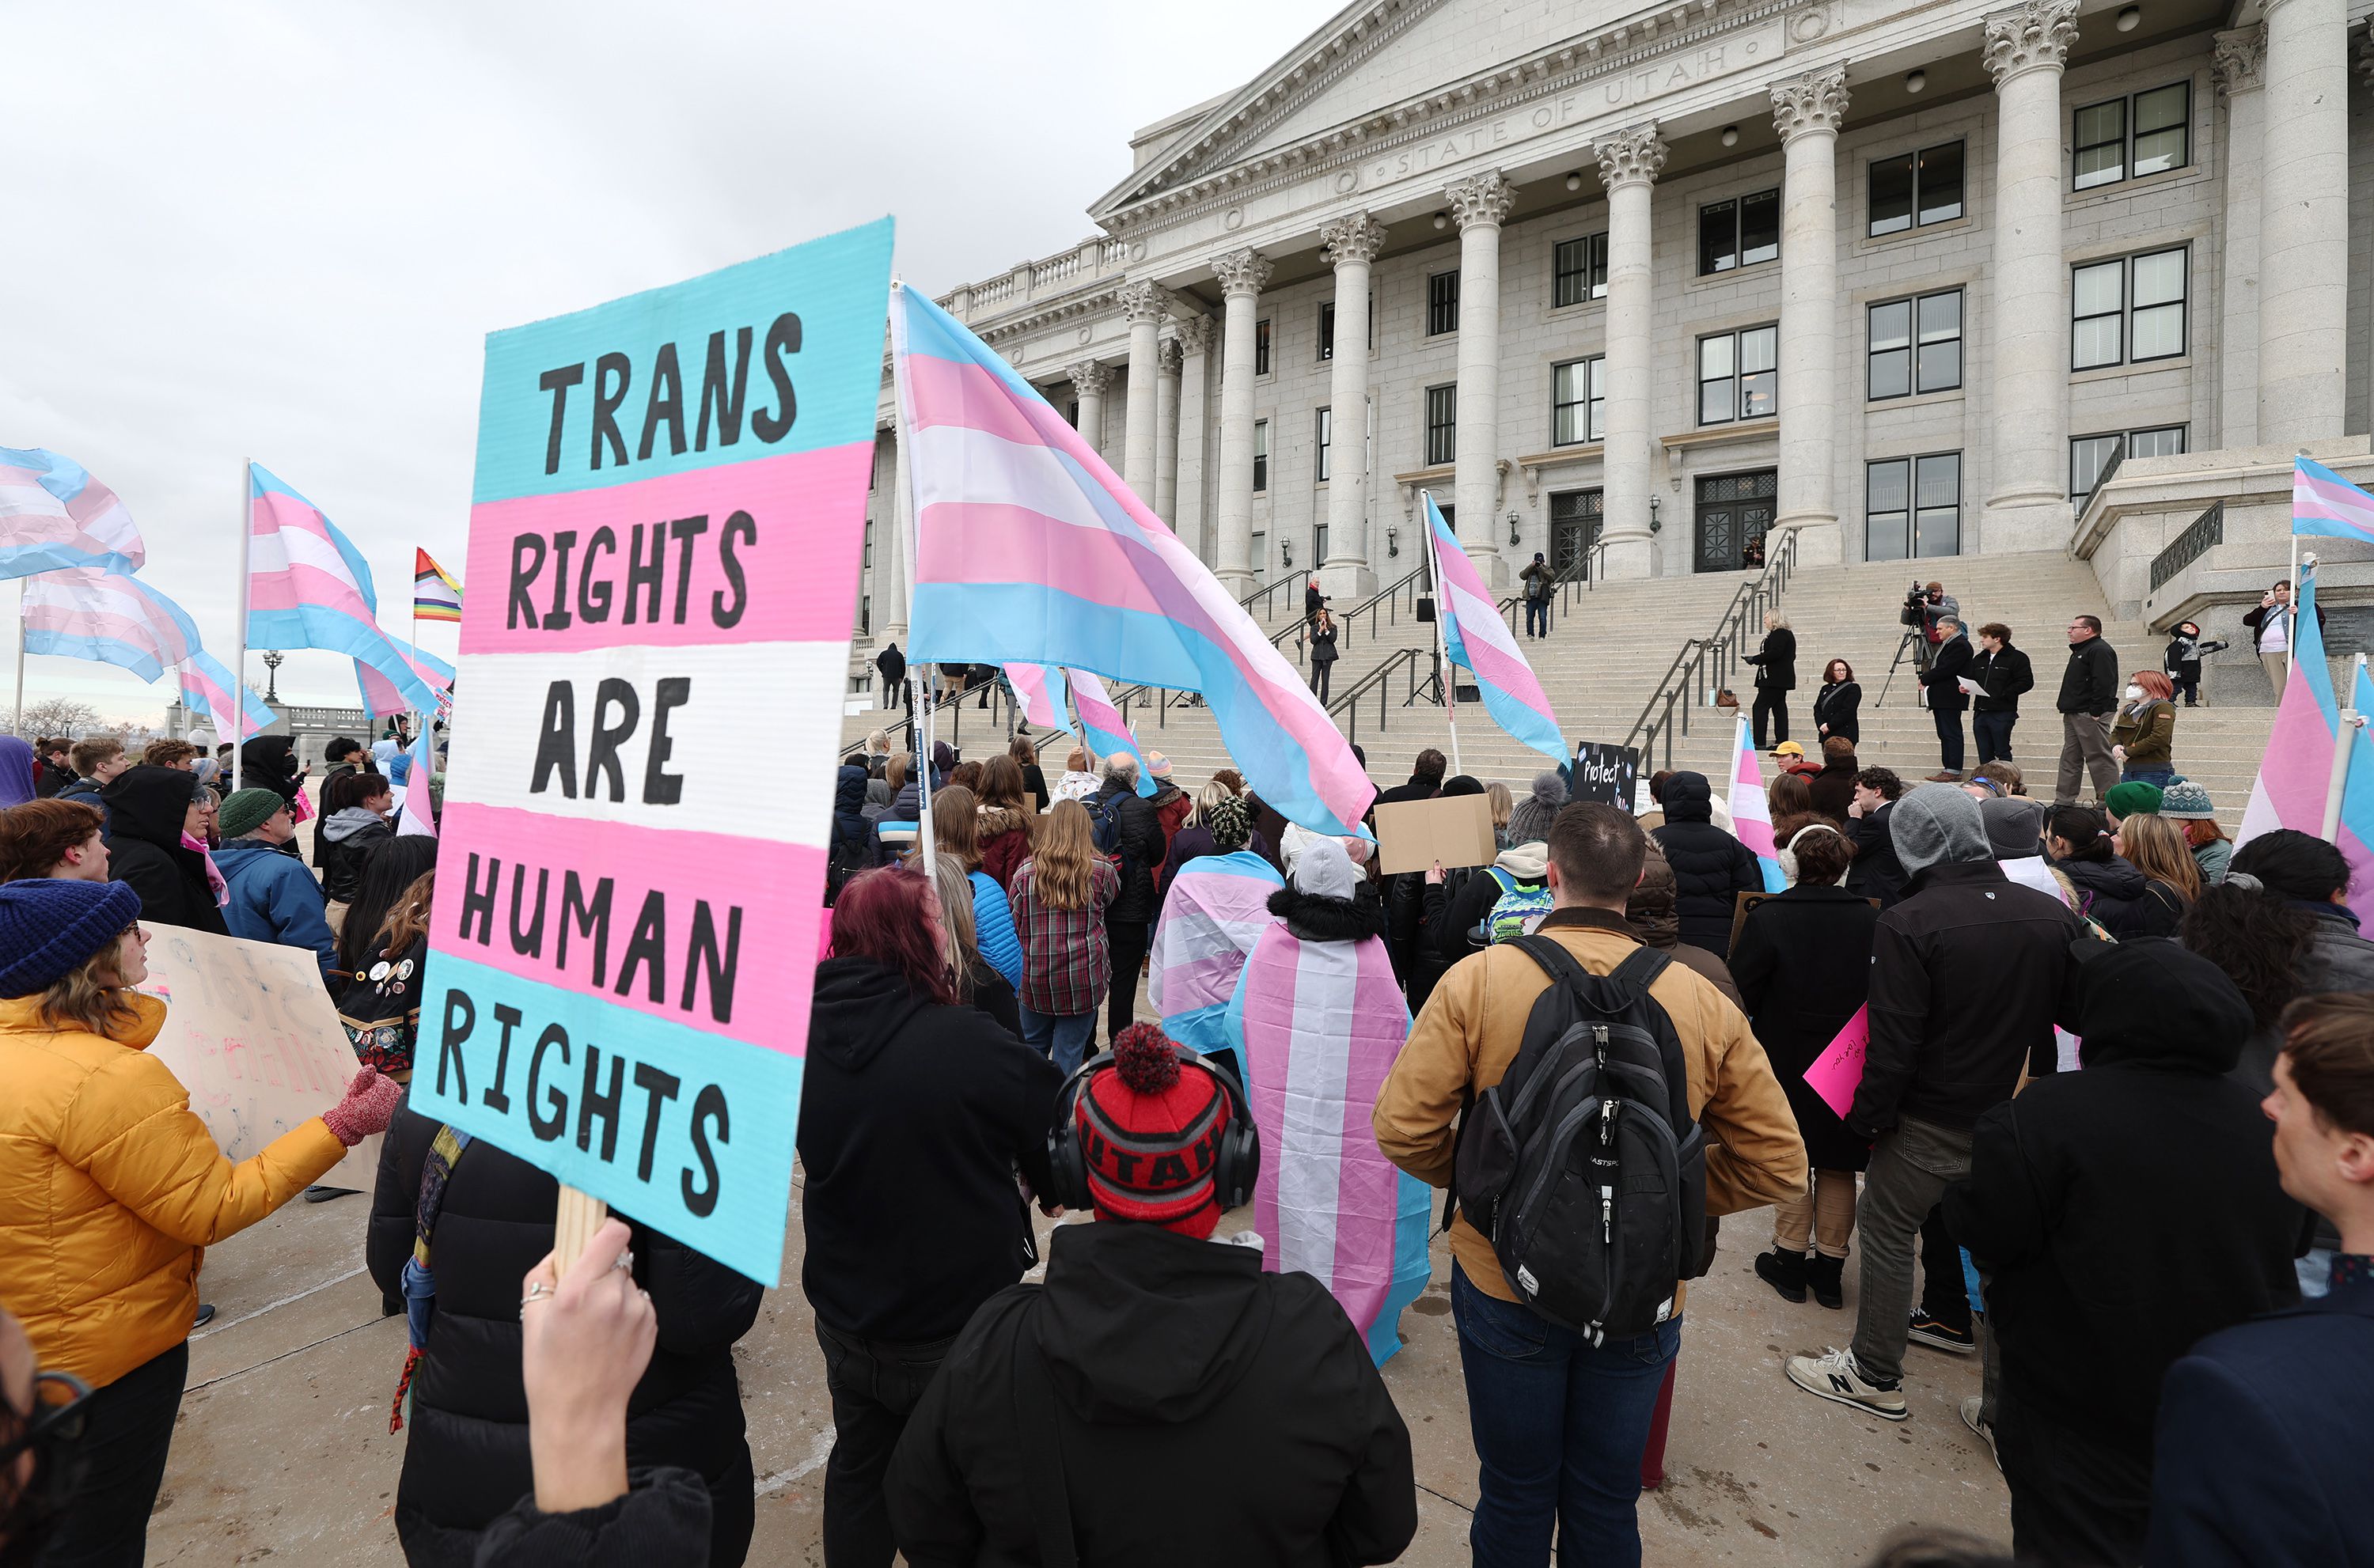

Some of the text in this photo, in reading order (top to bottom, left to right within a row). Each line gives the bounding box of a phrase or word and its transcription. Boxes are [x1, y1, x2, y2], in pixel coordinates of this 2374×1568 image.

[1397, 47, 1726, 173] STATE OF UTAH
[540, 312, 802, 475] TRANS
[507, 510, 757, 631] RIGHTS
[530, 678, 690, 805] ARE
[1584, 752, 1620, 785] Protect
[459, 853, 742, 1024] HUMAN
[437, 989, 730, 1218] RIGHTS
